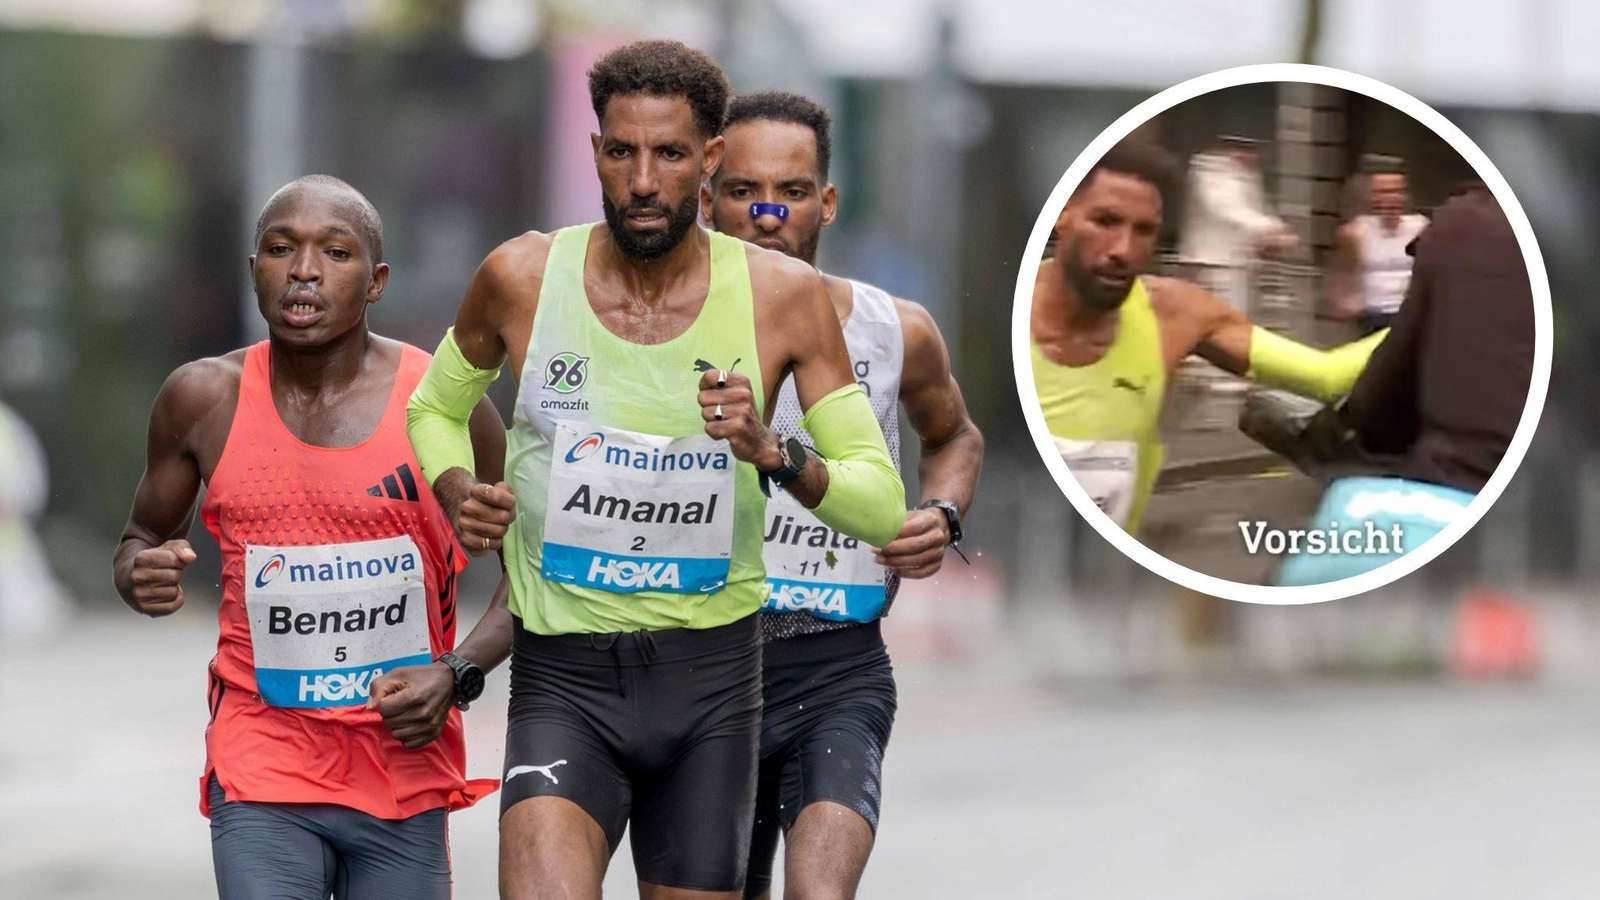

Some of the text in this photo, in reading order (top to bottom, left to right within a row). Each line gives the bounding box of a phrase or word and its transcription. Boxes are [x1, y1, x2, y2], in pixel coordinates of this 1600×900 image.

[548, 359, 584, 387] 96
[541, 399, 590, 410] amazfit
[605, 445, 728, 471] mainova
[562, 484, 718, 524] Amanal
[630, 536, 646, 551] 2
[289, 553, 415, 582] mainova
[586, 556, 680, 589] HOKA
[800, 561, 820, 576] 11
[763, 581, 848, 616] HOKA
[268, 594, 408, 635] Benard
[334, 646, 347, 662] 5
